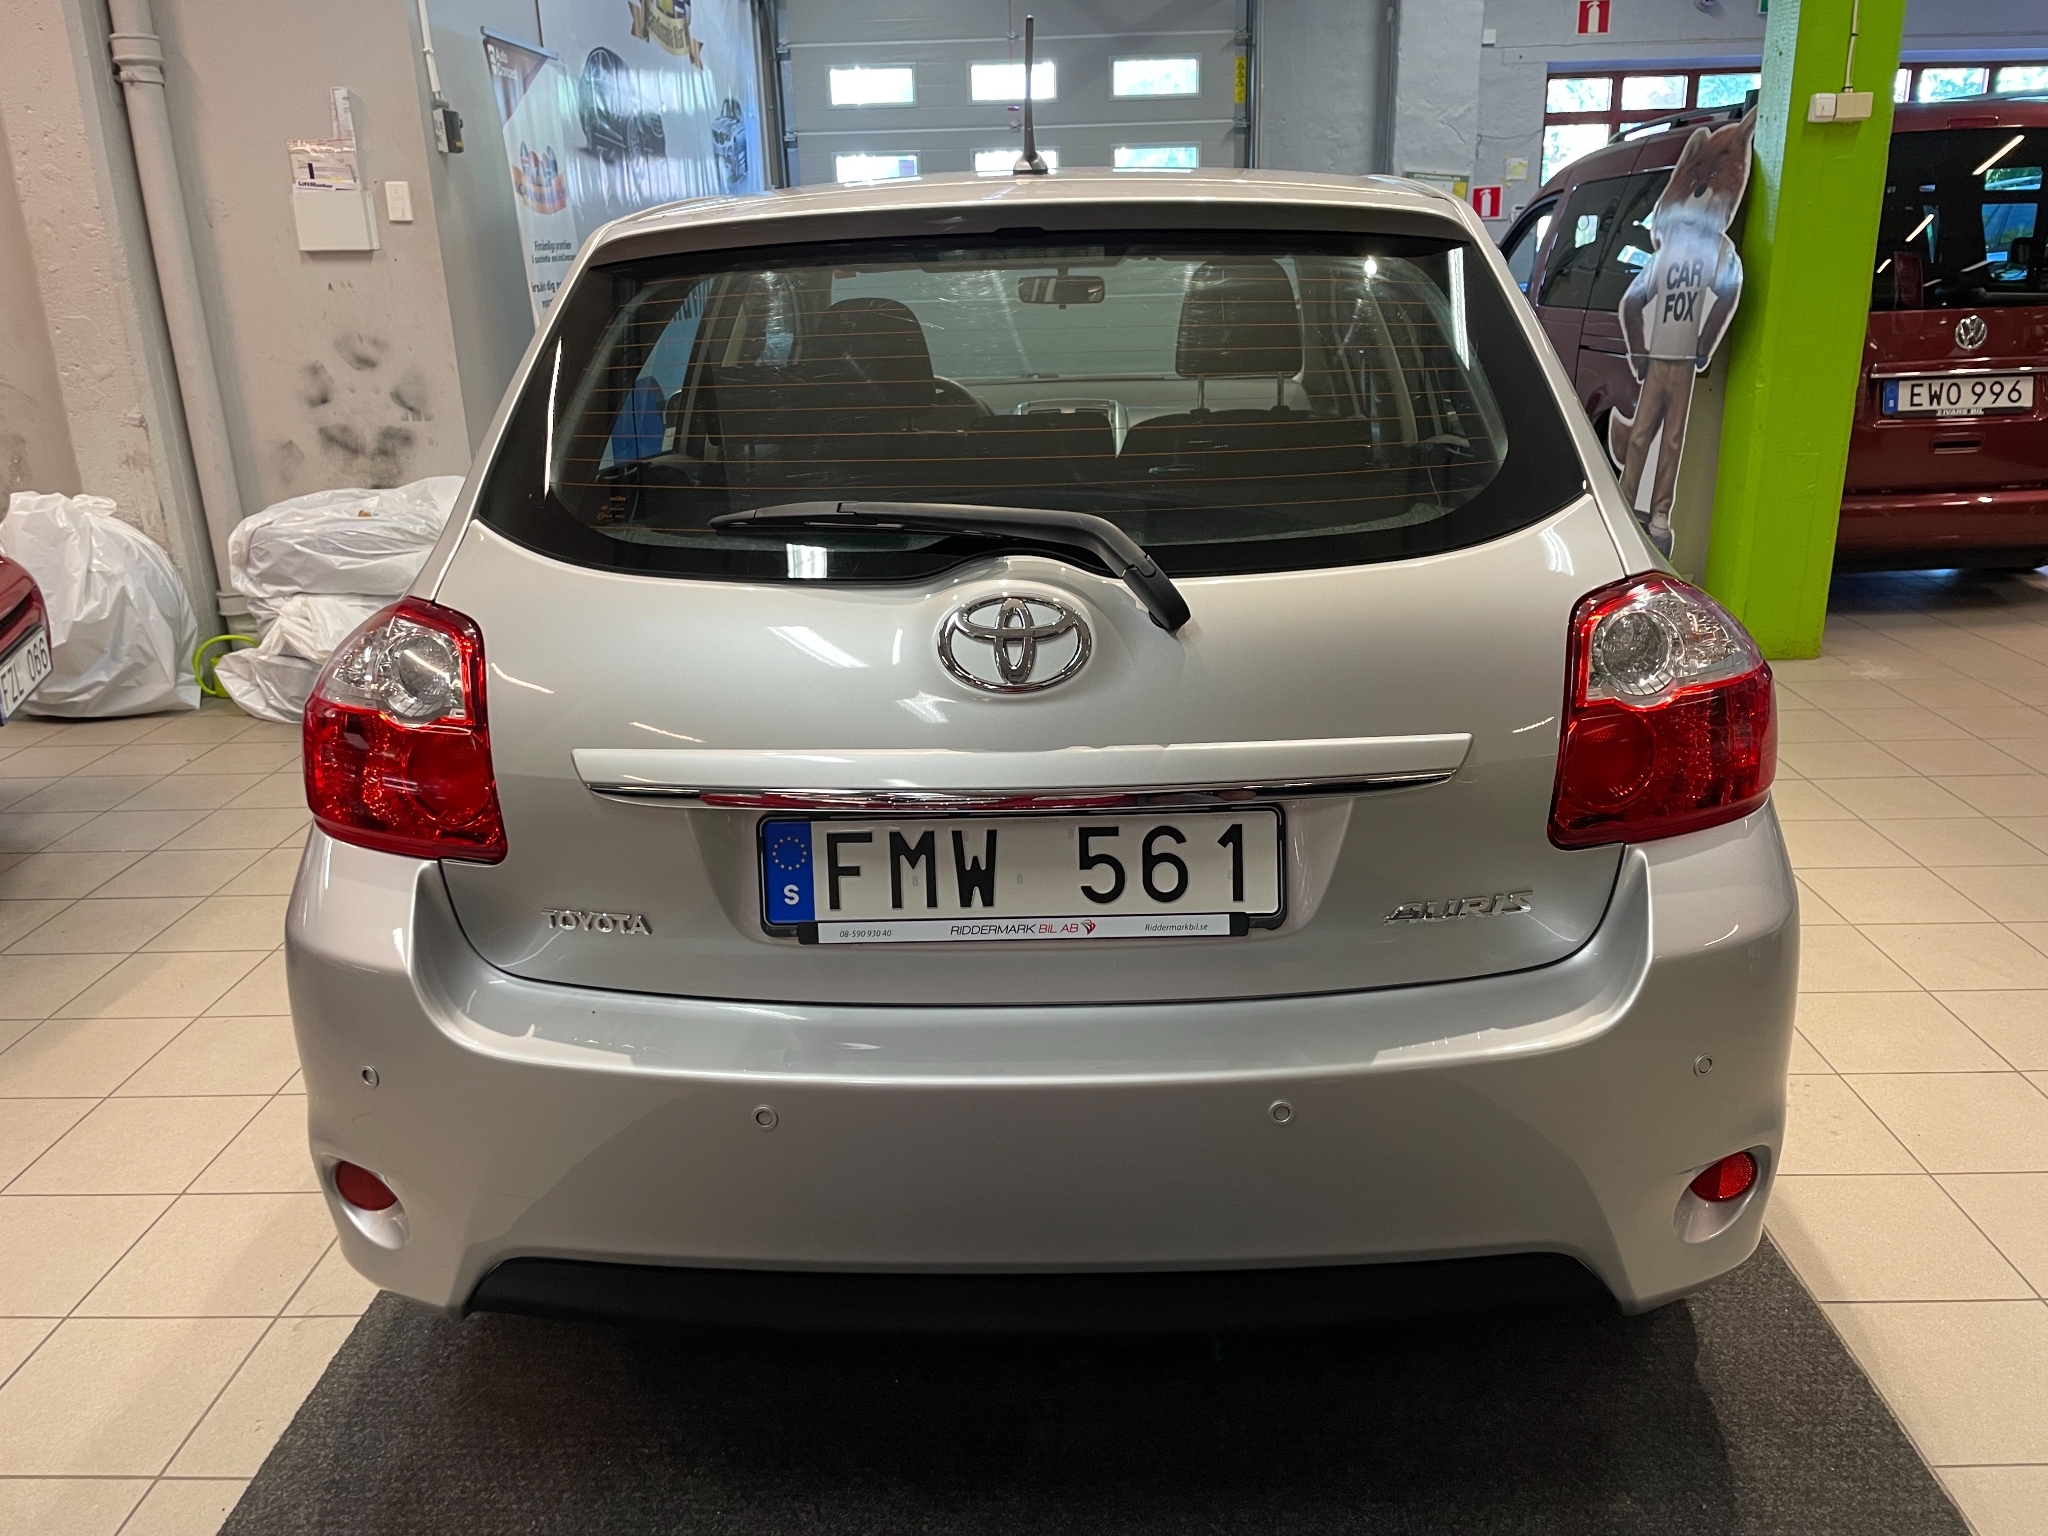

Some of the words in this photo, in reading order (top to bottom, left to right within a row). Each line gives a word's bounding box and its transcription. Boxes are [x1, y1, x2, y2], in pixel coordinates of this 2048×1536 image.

[1667, 259, 1705, 290] CAR
[1663, 291, 1698, 324] FOX
[1910, 382, 1962, 407] EWO
[1971, 380, 2022, 405] 996
[0, 662, 24, 711] FZL
[27, 637, 48, 681] 066
[827, 829, 998, 910] FMW
[1078, 824, 1244, 903] 561
[783, 884, 800, 905] S
[1383, 889, 1534, 925] AURIS
[541, 908, 652, 936] TOYOTA
[839, 930, 866, 938] 08-590
[867, 929, 881, 938] 930
[882, 929, 892, 937] 40
[950, 924, 1037, 936] RIDDERMARK
[1038, 923, 1058, 934] BIL
[1060, 923, 1079, 934] AB
[1144, 922, 1209, 932] Riddermarkbil.se
